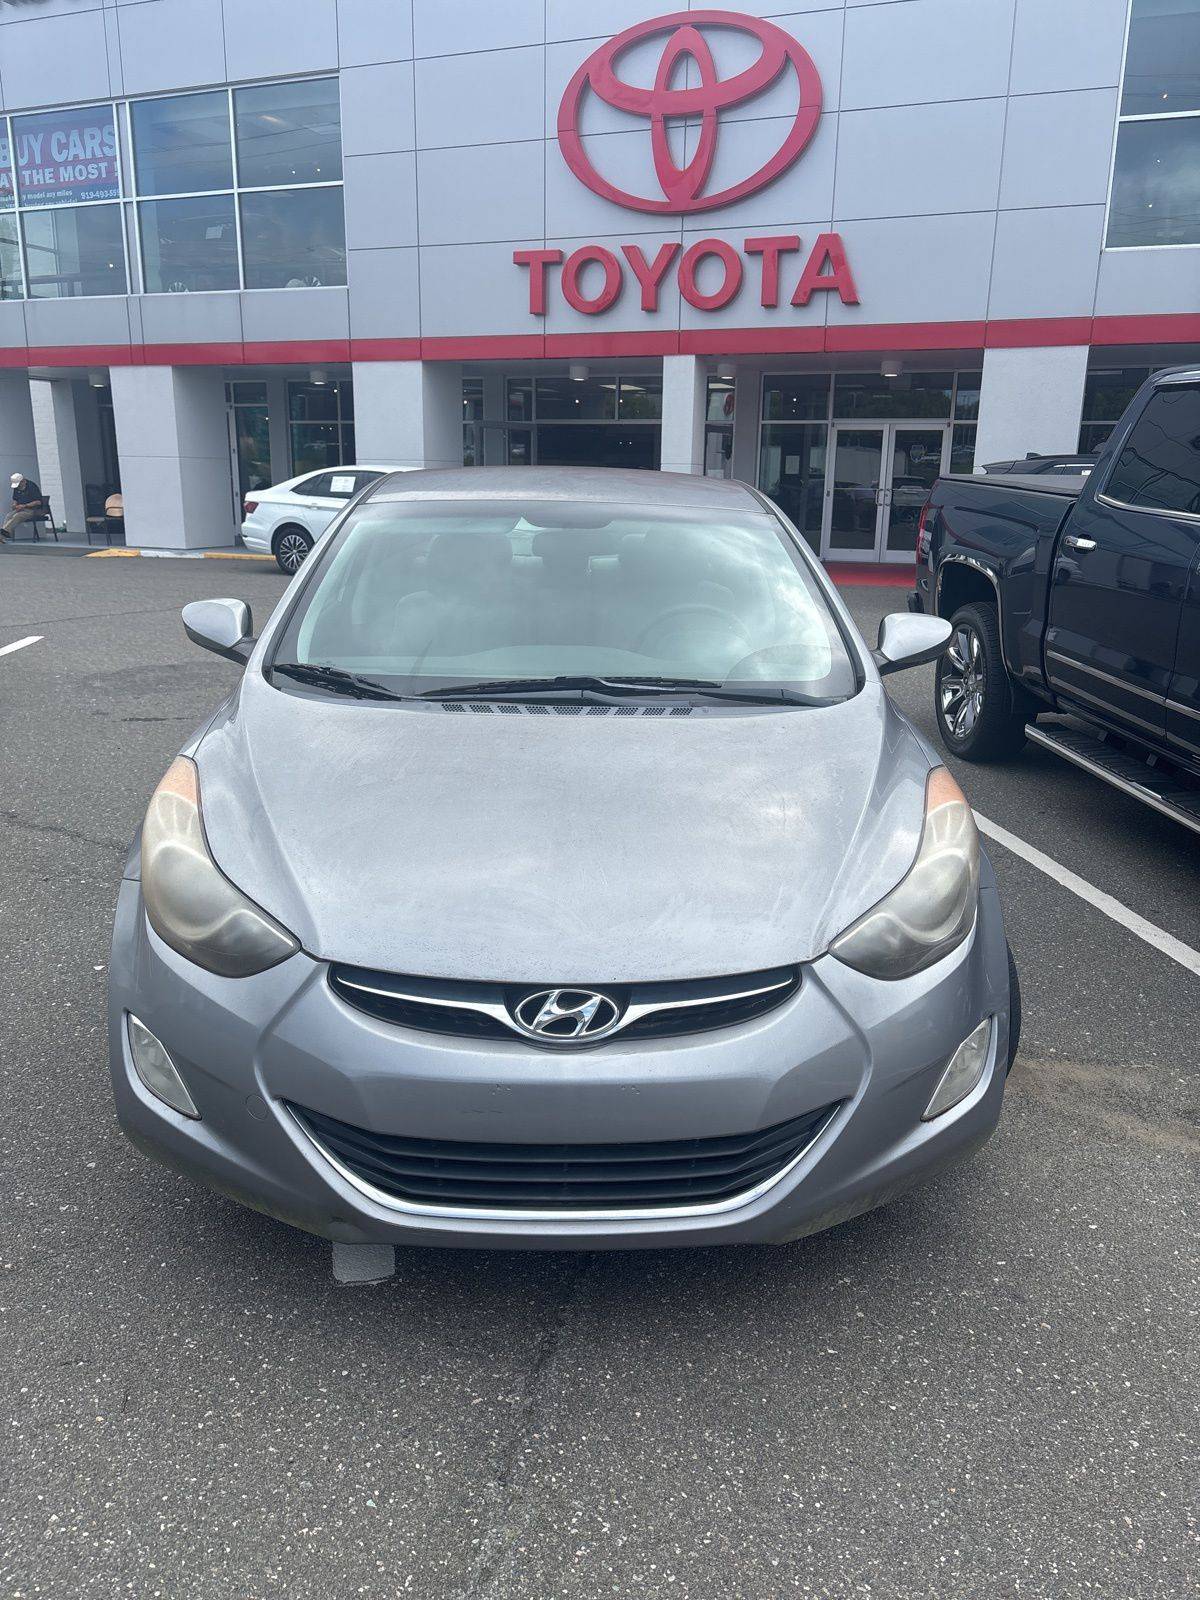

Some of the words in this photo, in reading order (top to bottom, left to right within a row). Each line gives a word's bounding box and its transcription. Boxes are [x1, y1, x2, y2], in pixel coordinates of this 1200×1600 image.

[0, 133, 44, 168] BUY
[50, 124, 117, 163] CARS
[22, 167, 56, 186] THE
[59, 162, 108, 182] MOST
[513, 232, 860, 316] TOYOTA
